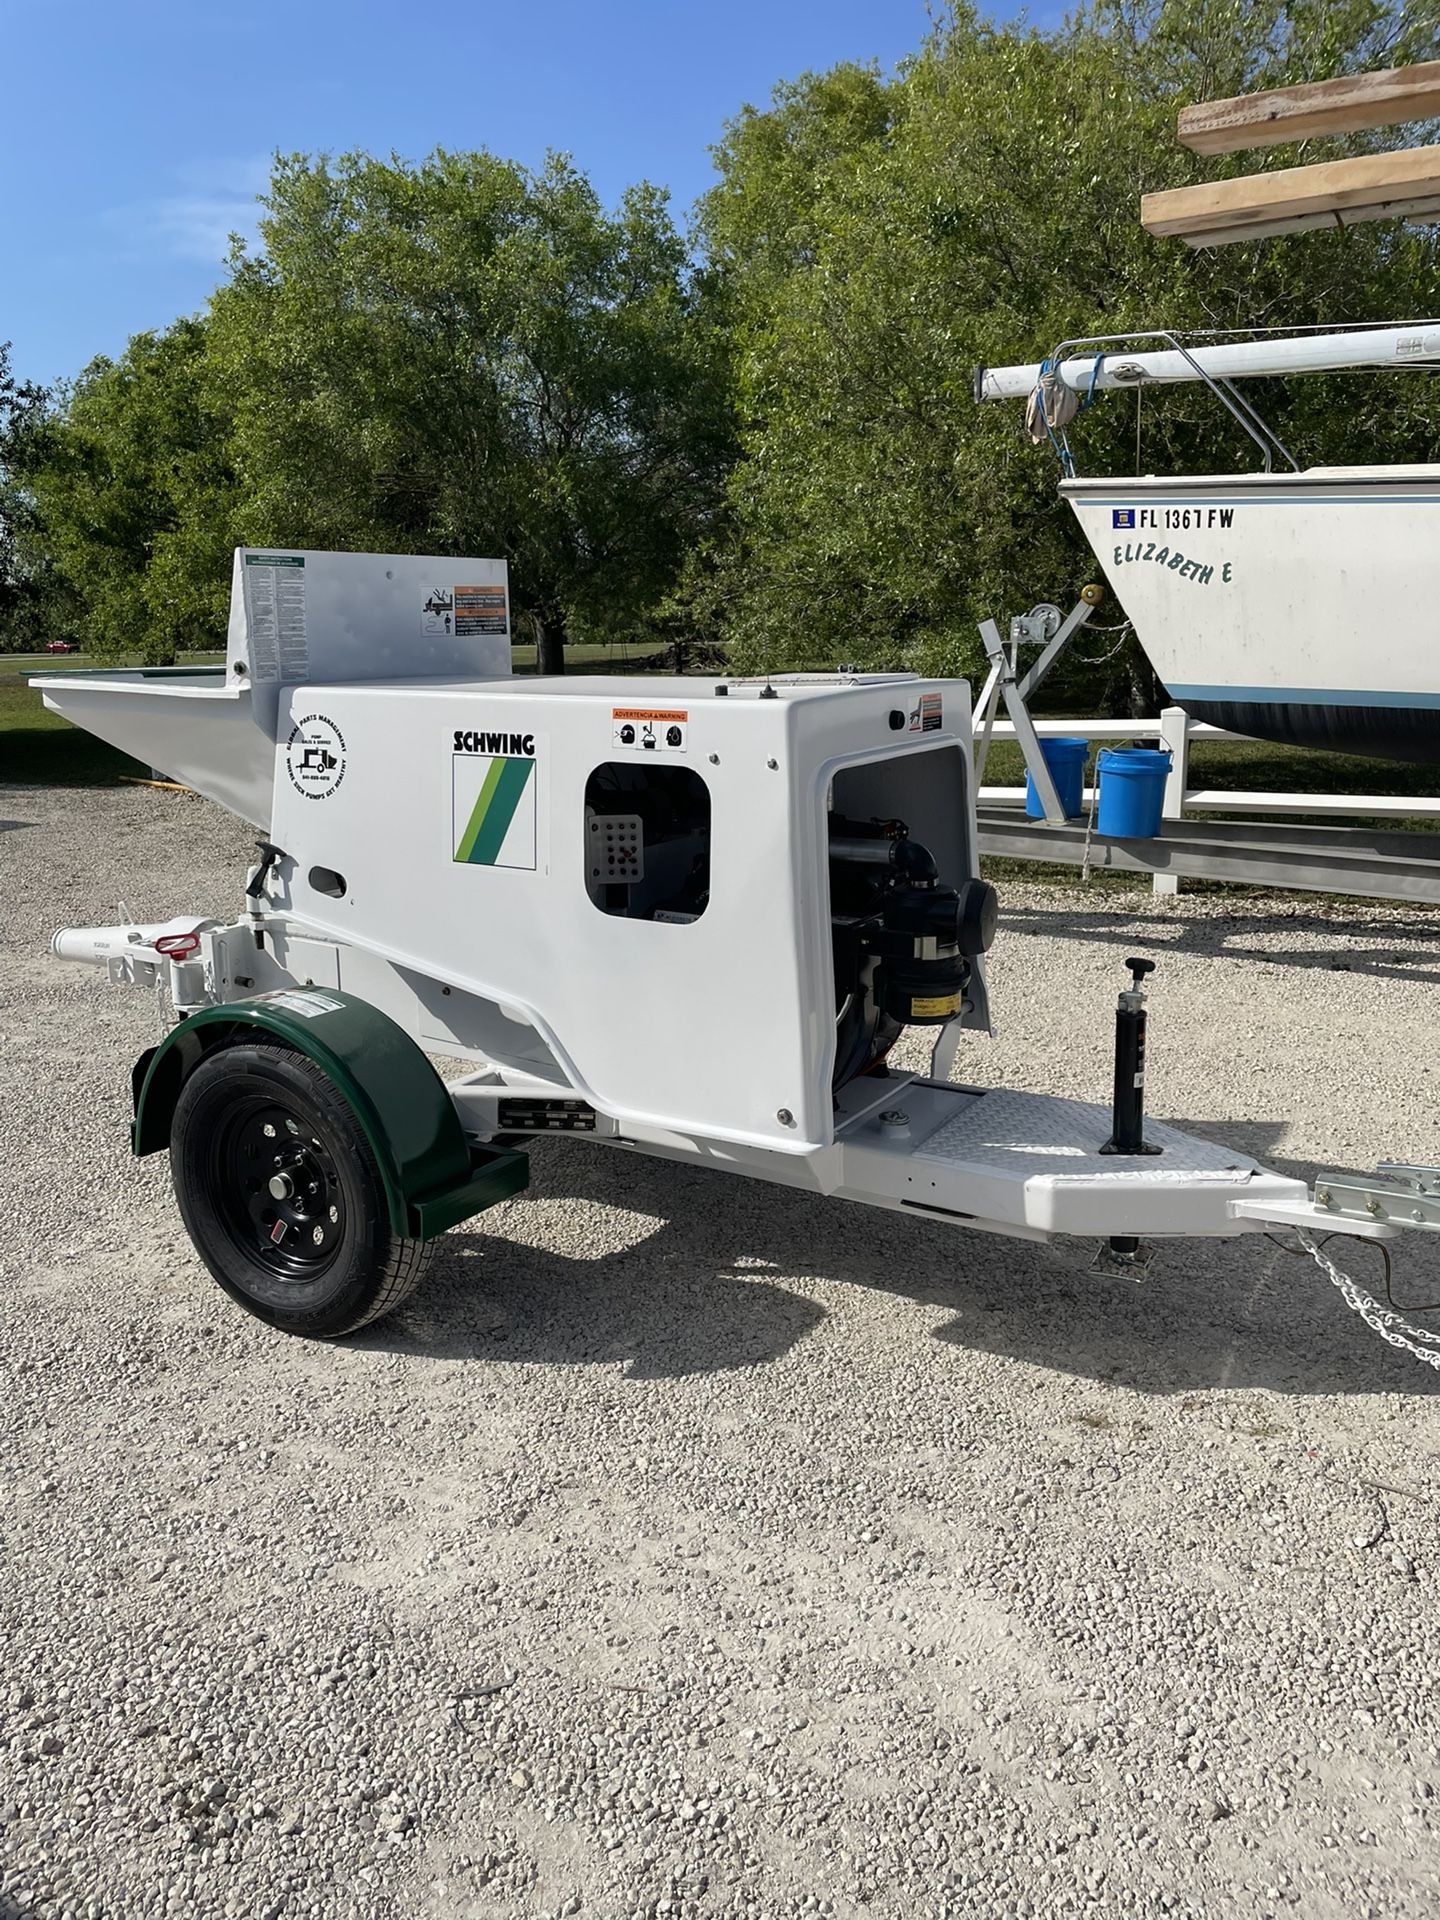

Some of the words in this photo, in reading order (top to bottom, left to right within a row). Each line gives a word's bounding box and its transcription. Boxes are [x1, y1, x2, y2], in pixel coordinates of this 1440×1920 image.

[1140, 509, 1158, 528] FL
[1165, 509, 1202, 529] 1367
[1208, 508, 1234, 528] FW
[1113, 542, 1214, 585] ELIZABETH
[1222, 562, 1233, 583] E
[614, 711, 653, 720] ADVERTENCIA
[658, 713, 686, 721] WARNING
[299, 714, 317, 727] PARTS
[318, 714, 347, 752] MANAGEMENT
[453, 730, 535, 756] SCHWING
[286, 758, 296, 781] WHERE
[294, 781, 305, 795] SICK
[305, 792, 325, 800] PUMPS
[326, 787, 336, 797] GET
[335, 759, 346, 788] HEALTHY
